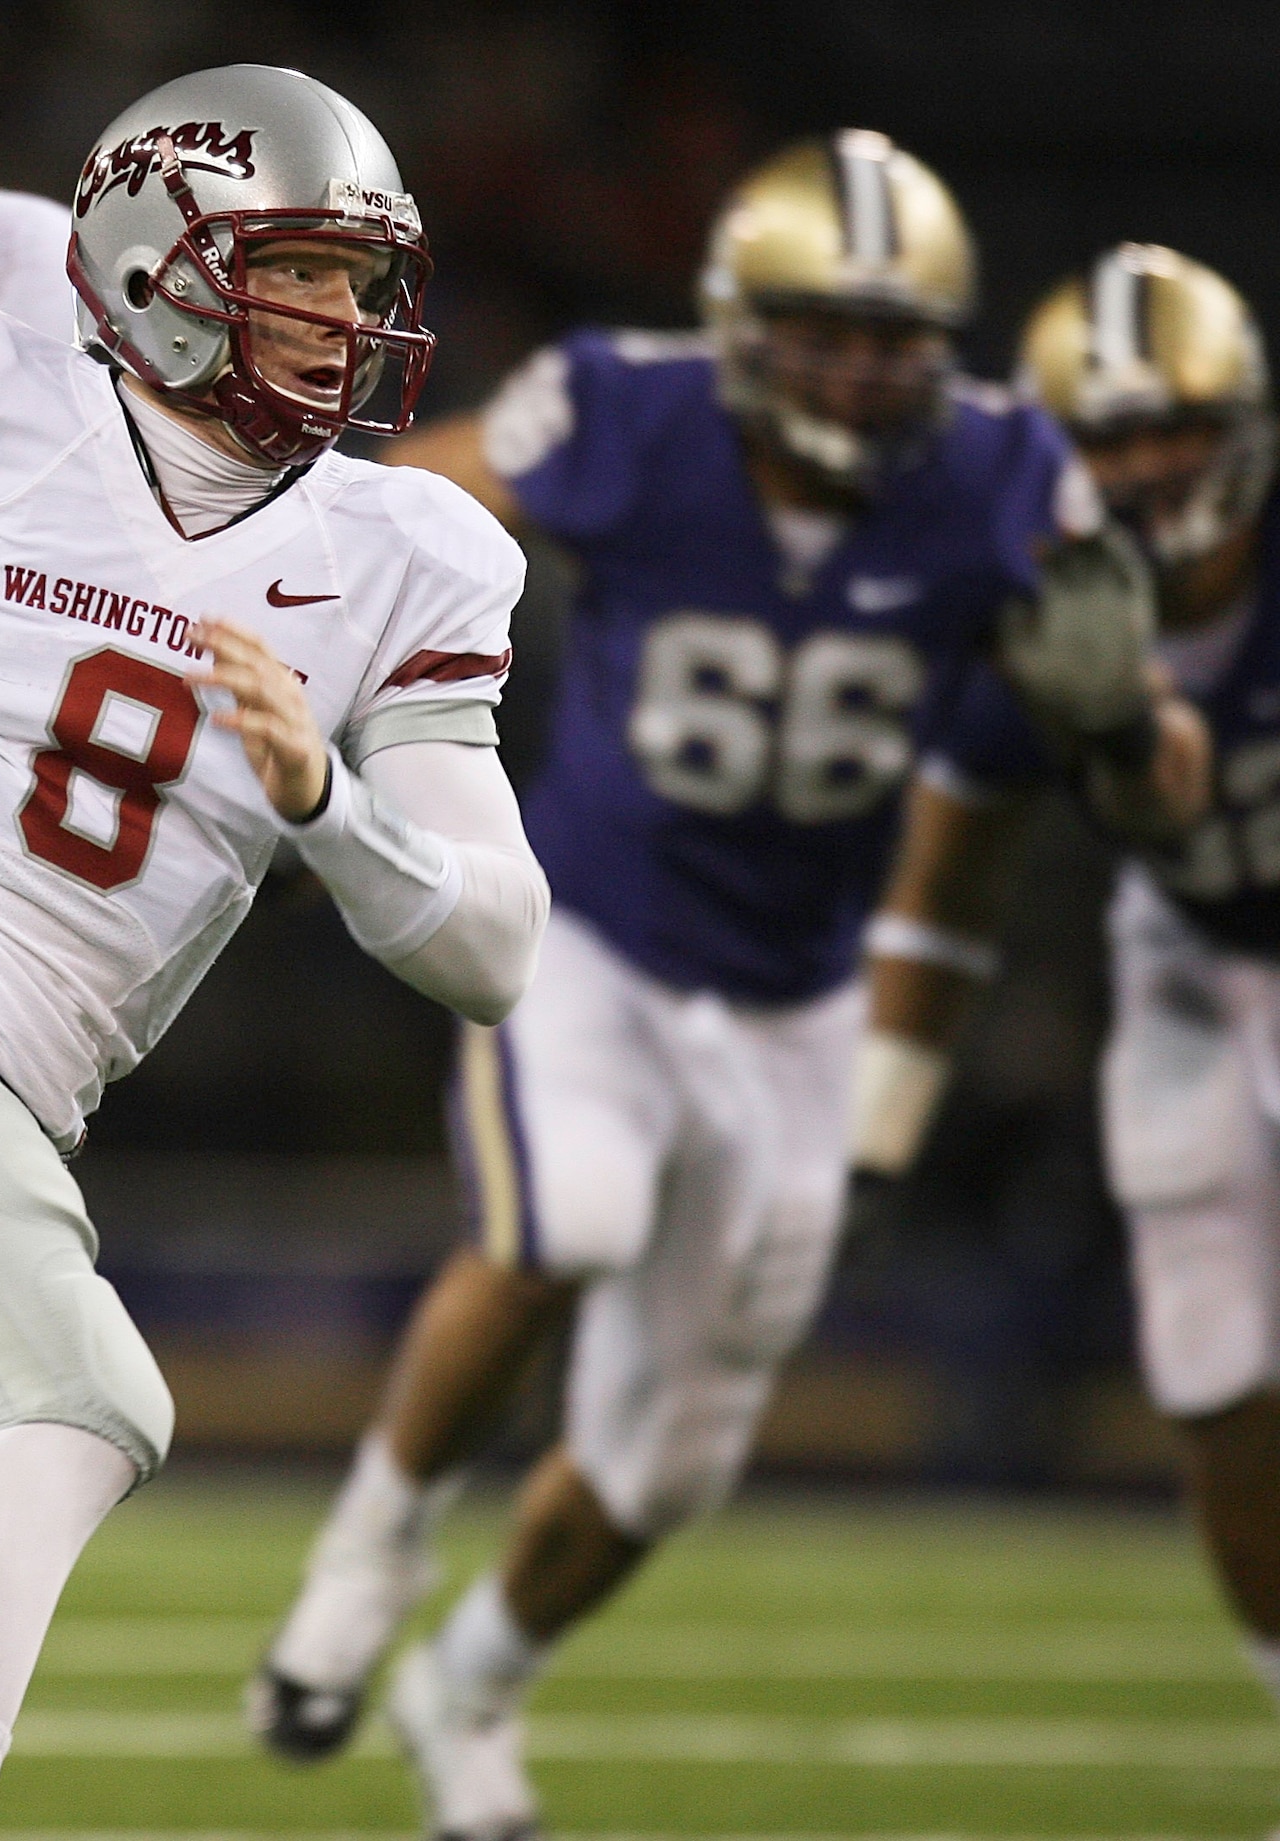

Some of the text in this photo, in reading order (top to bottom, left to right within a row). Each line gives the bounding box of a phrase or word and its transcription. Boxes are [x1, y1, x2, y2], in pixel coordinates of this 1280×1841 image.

[76, 121, 260, 219] Cougars
[301, 422, 332, 438] Riddell
[13, 643, 208, 897] 8
[631, 611, 925, 822] 66
